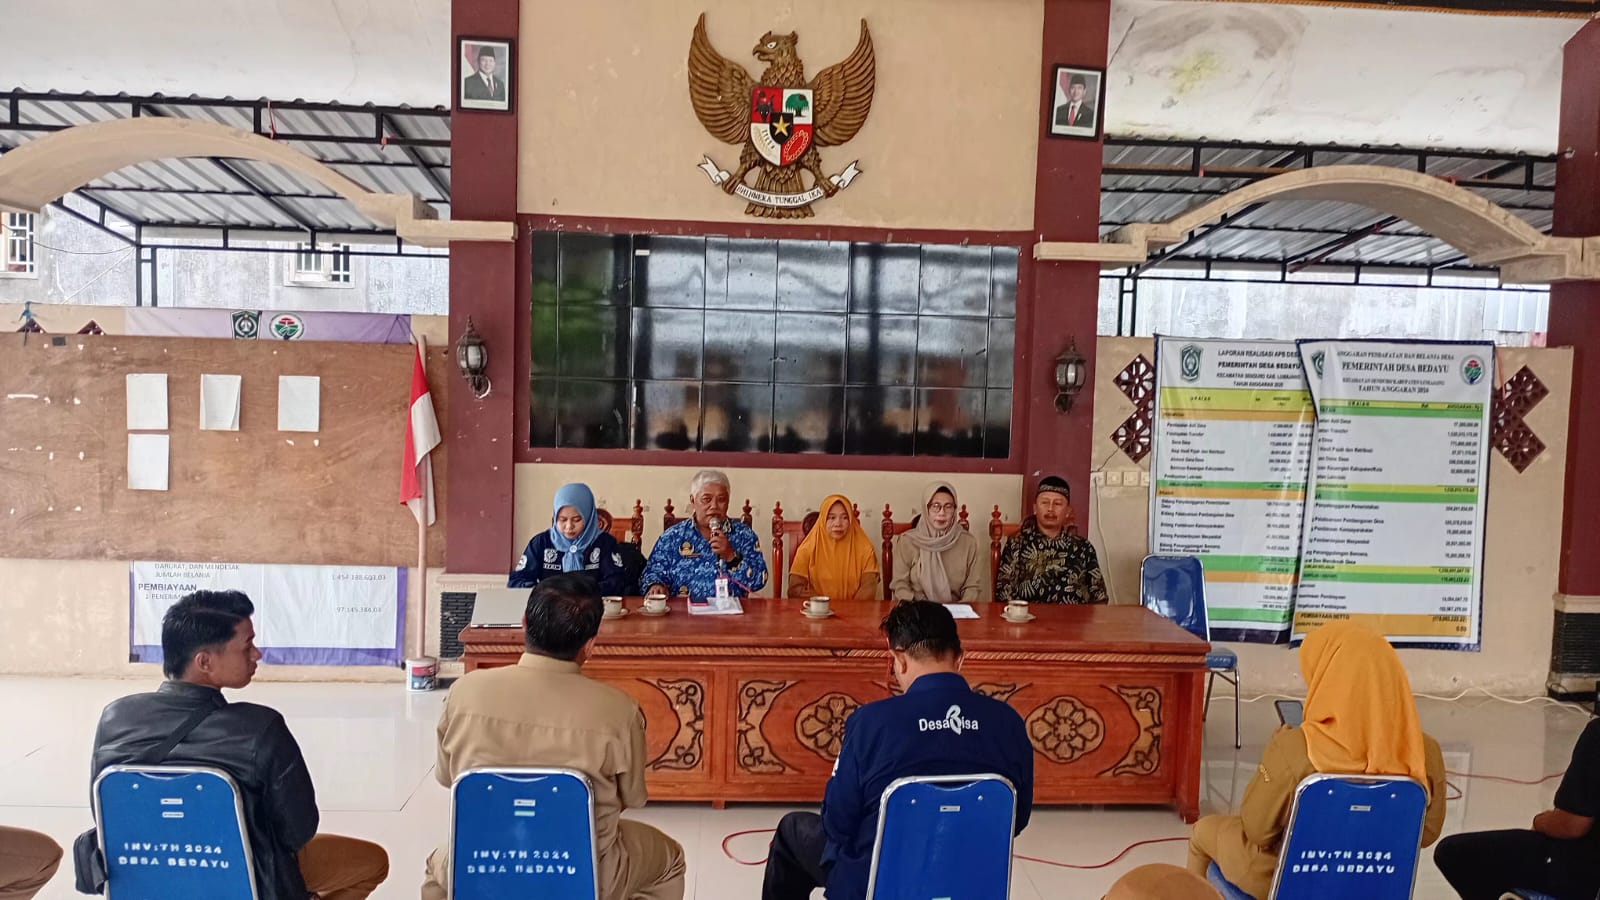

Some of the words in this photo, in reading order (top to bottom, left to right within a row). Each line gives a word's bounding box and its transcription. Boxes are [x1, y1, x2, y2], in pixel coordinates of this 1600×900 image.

[737, 186, 772, 203] BHINNEKA
[774, 194, 806, 204] TUNGGAL
[808, 188, 822, 200] IKA
[1218, 361, 1258, 369] PEMERINTAH
[1342, 362, 1395, 372] PEMERINTAH
[1396, 364, 1416, 373] DESA
[1418, 364, 1449, 374] BEDAYU
[138, 583, 198, 592] PEMBIAYAAN
[184, 844, 222, 854] 2024
[533, 850, 570, 860] 2024
[1356, 850, 1392, 862] 2024
[118, 856, 160, 866] DESA
[167, 858, 230, 869] BEDAYU
[467, 864, 507, 874] DESA
[515, 864, 576, 876] BEDAYU
[1292, 864, 1328, 874] DESA
[1336, 864, 1396, 874] BEDAYU
